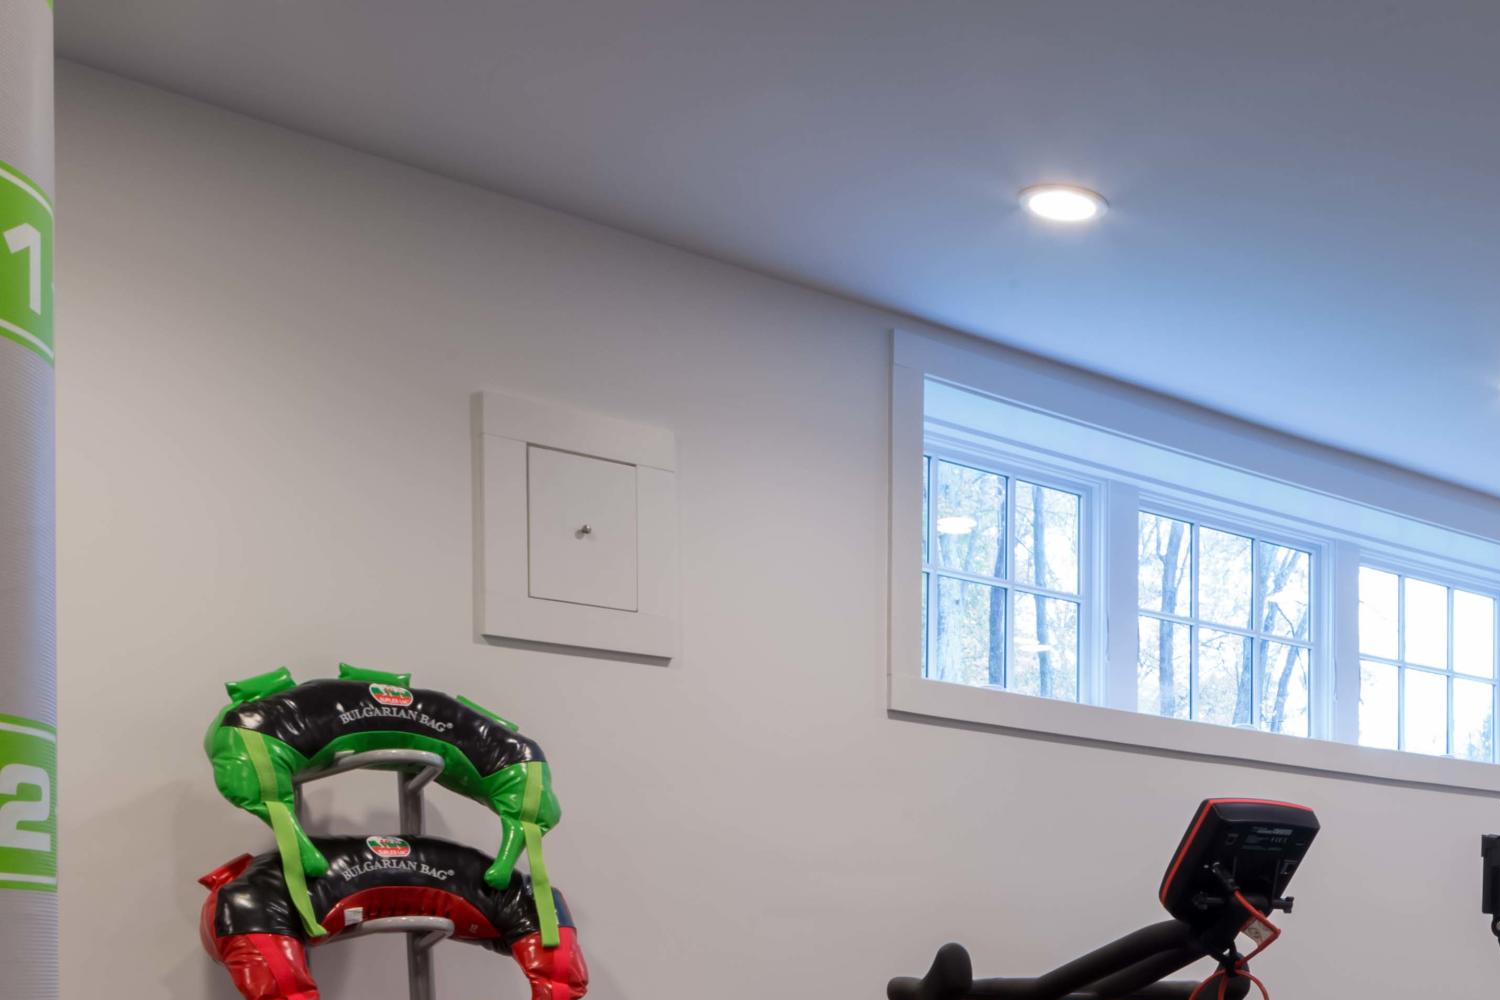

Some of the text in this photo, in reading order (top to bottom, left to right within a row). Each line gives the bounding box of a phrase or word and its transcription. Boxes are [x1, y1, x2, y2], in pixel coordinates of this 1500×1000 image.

[3, 223, 41, 316] 1
[340, 706, 418, 725] BULGARIAN
[0, 763, 51, 852] 2
[341, 859, 418, 881] BULGARIAN
